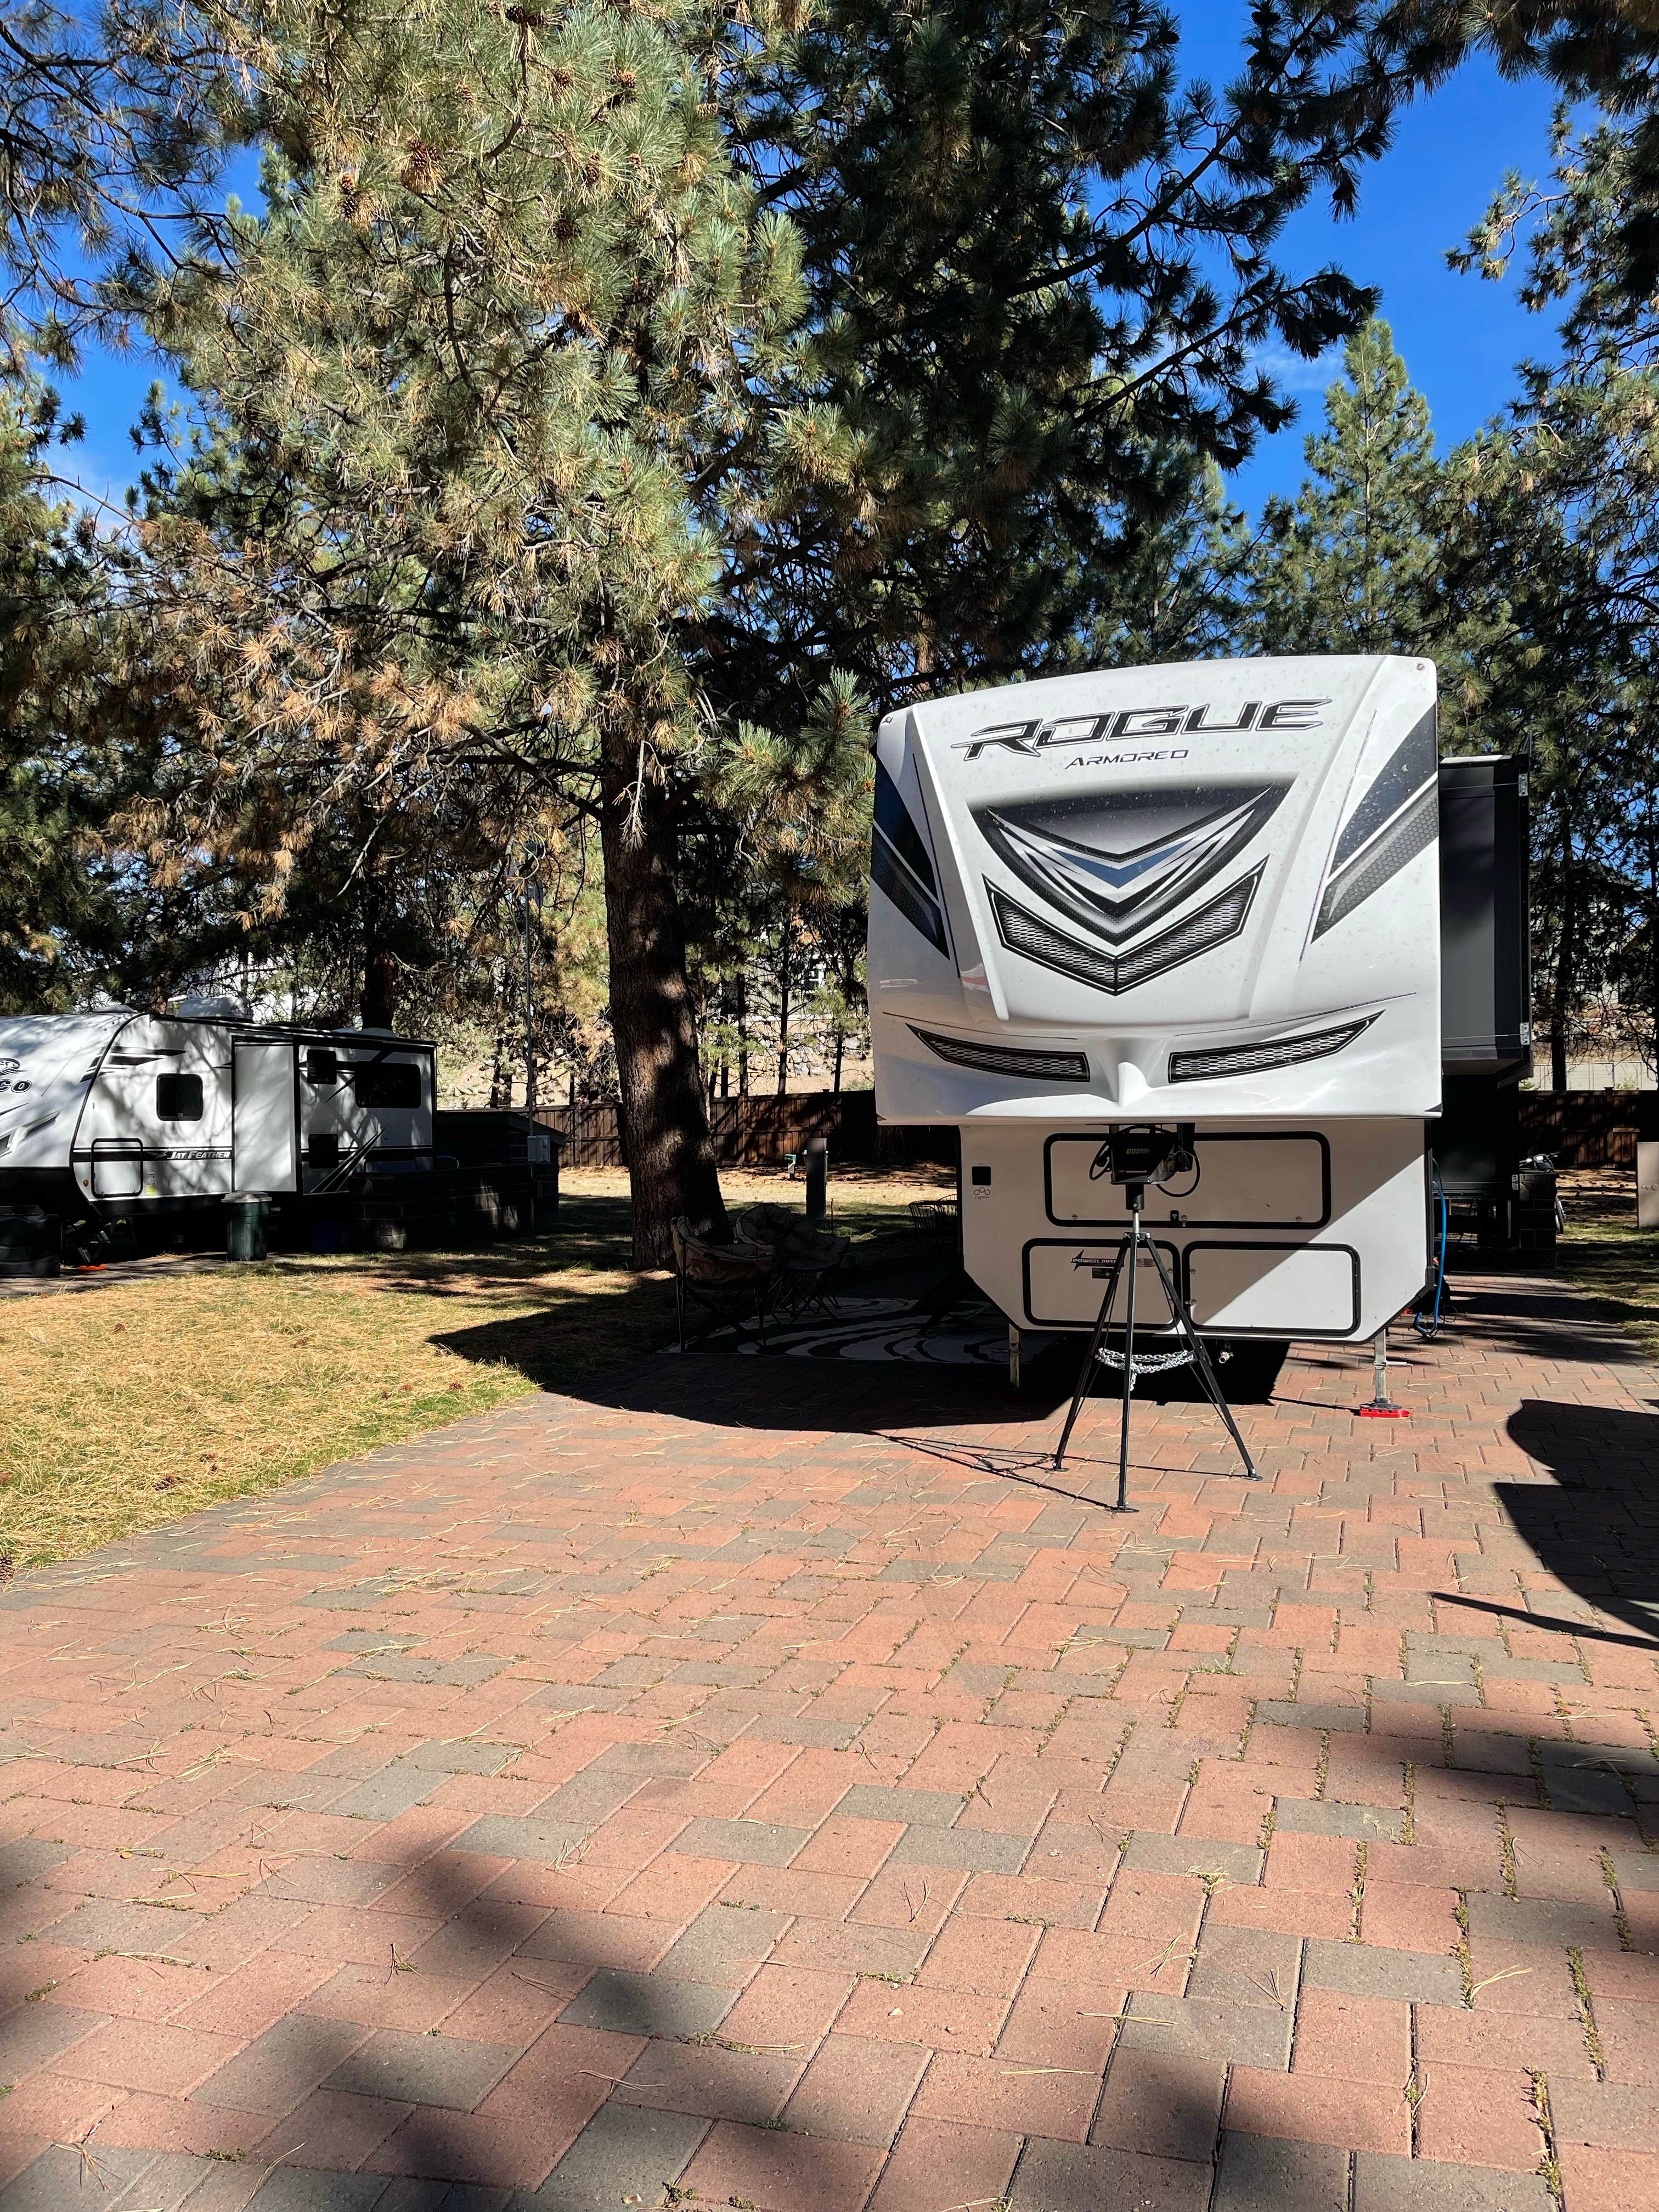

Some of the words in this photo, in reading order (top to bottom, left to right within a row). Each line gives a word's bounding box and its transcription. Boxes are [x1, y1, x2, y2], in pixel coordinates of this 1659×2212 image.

[951, 698, 1333, 761] ROGUE
[1064, 749, 1189, 770] ARMORED
[167, 1151, 188, 1160] JAY
[188, 1151, 231, 1159] FEATHER
